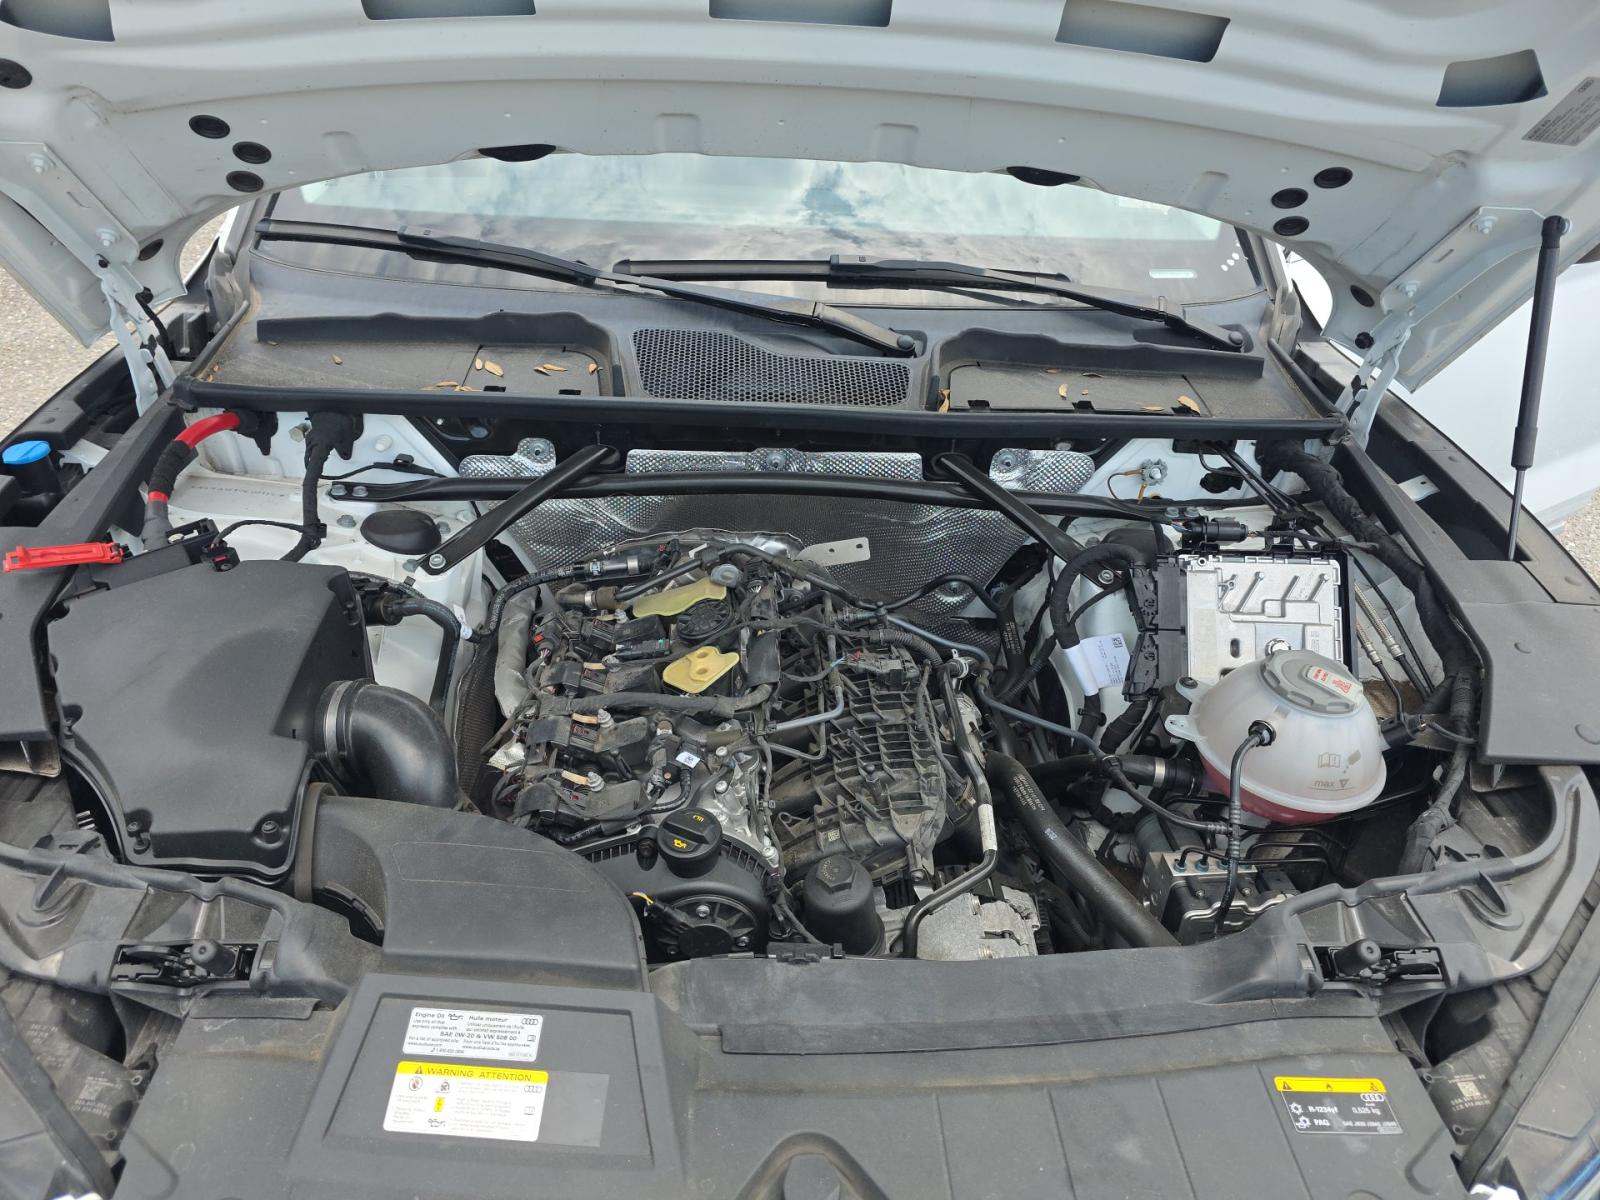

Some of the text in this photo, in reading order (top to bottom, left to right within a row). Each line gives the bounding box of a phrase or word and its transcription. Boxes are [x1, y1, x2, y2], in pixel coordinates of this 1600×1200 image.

[1314, 780, 1336, 788] max
[415, 1011, 436, 1019] Engine
[426, 1067, 532, 1081] WARNING ATTENTION
